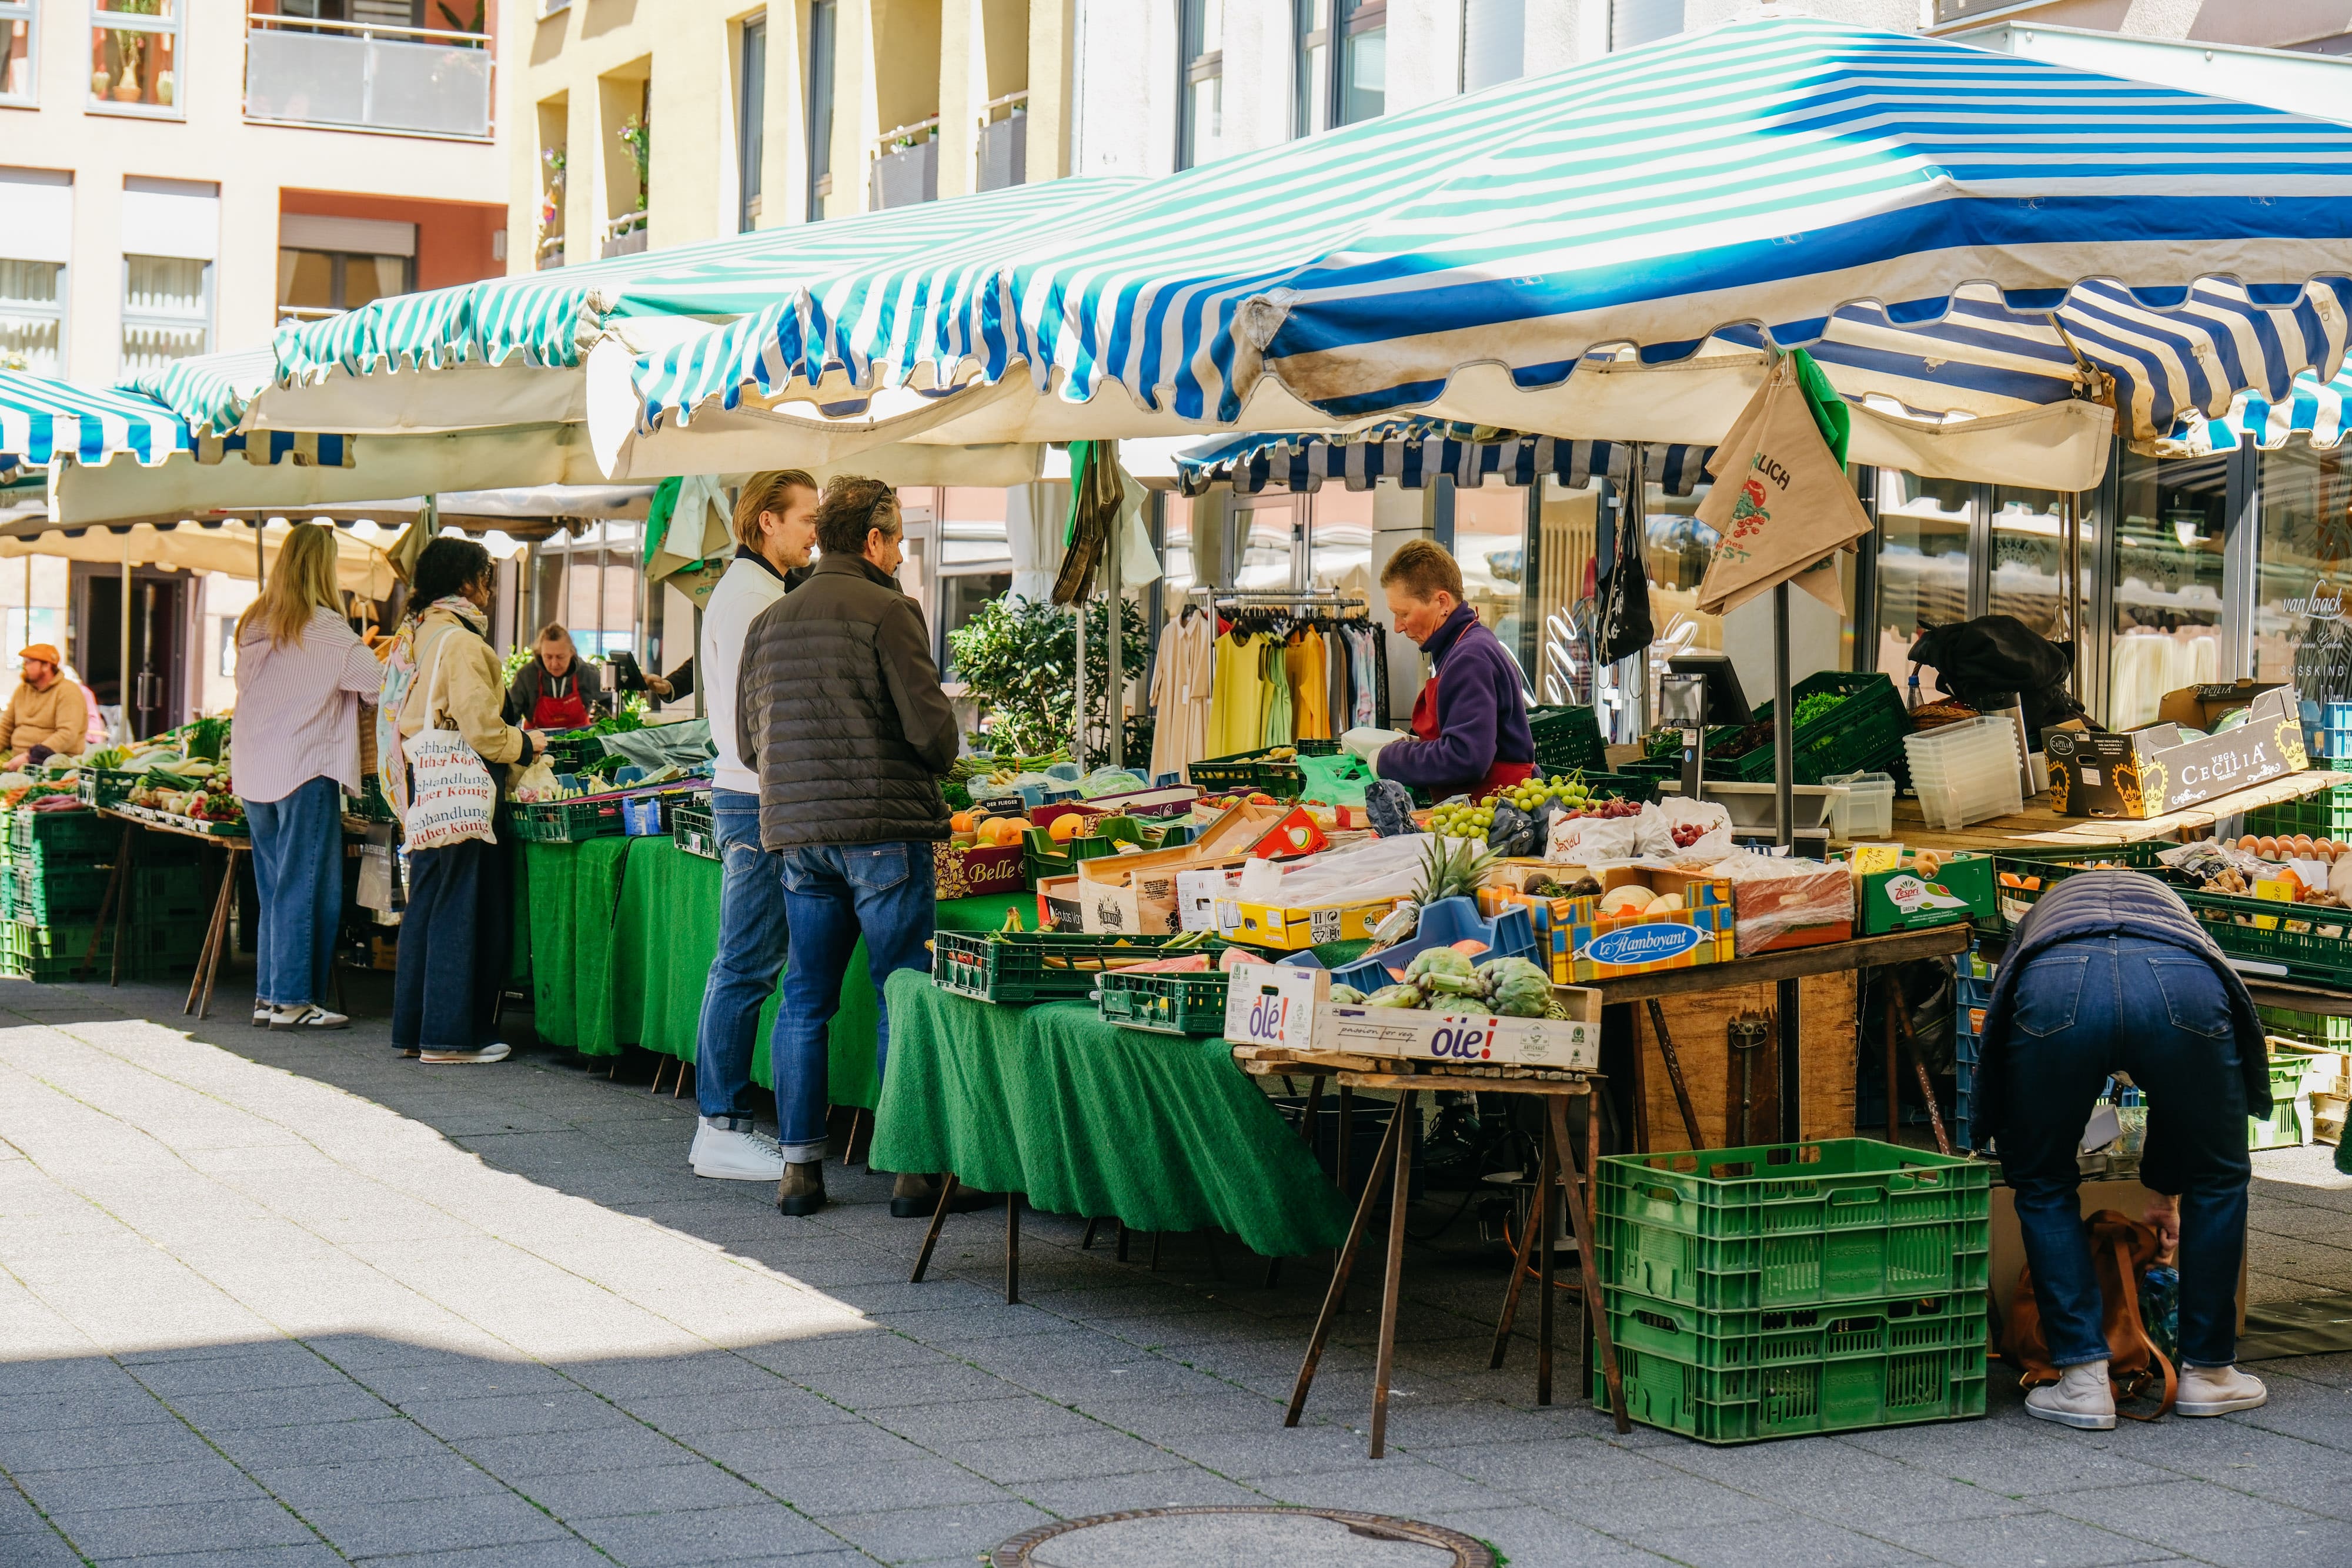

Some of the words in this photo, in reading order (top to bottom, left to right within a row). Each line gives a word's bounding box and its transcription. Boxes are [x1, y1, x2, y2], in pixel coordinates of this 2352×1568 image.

[2283, 597, 2305, 612] van
[2300, 579, 2346, 619] Laack
[2181, 744, 2267, 785] CECILIA
[2211, 751, 2235, 764] VEGA
[447, 785, 488, 800] König
[450, 820, 488, 834] König
[969, 859, 1015, 882] Belle
[1895, 887, 1919, 900] Zespri
[1103, 912, 1118, 924] BRIO
[1599, 942, 1610, 955] Le
[1611, 930, 1687, 952] Flamboyant
[1339, 1026, 1378, 1036] passion
